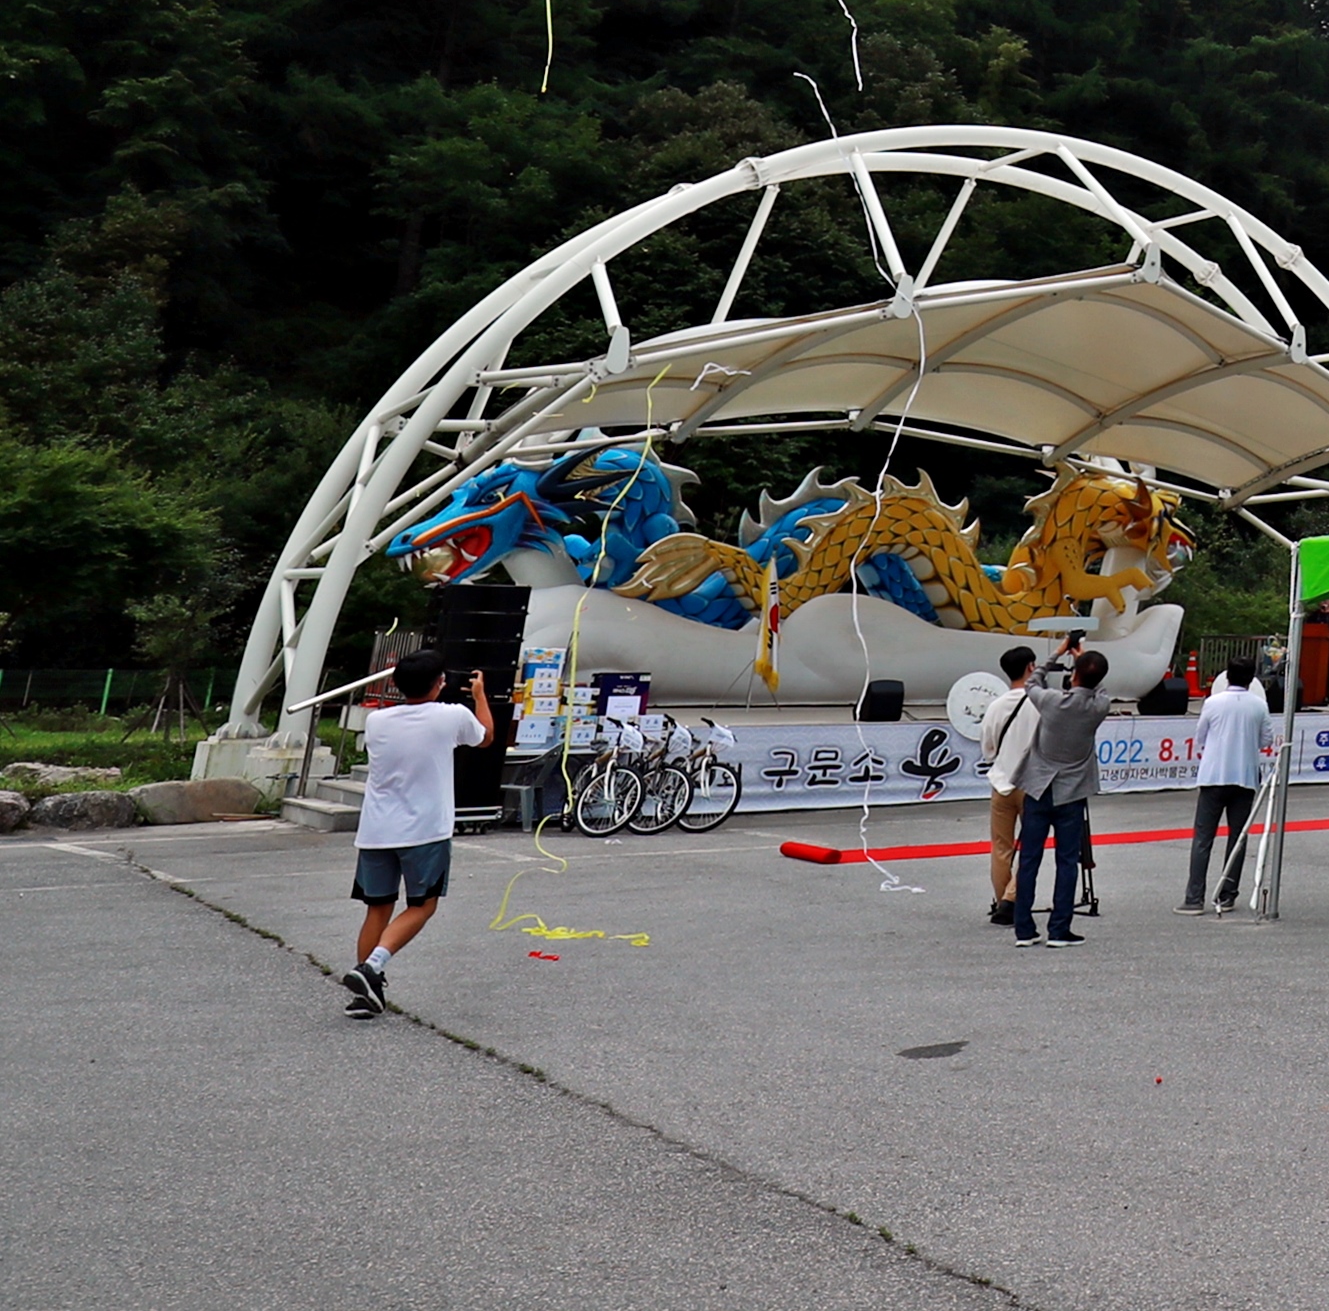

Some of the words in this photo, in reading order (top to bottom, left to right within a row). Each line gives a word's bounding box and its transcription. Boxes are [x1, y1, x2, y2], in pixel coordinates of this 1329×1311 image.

[763, 747, 885, 789] 구문소
[900, 727, 962, 799] 용
[1098, 739, 1150, 765] 022.
[1100, 766, 1188, 782] 고생대자연사박물관
